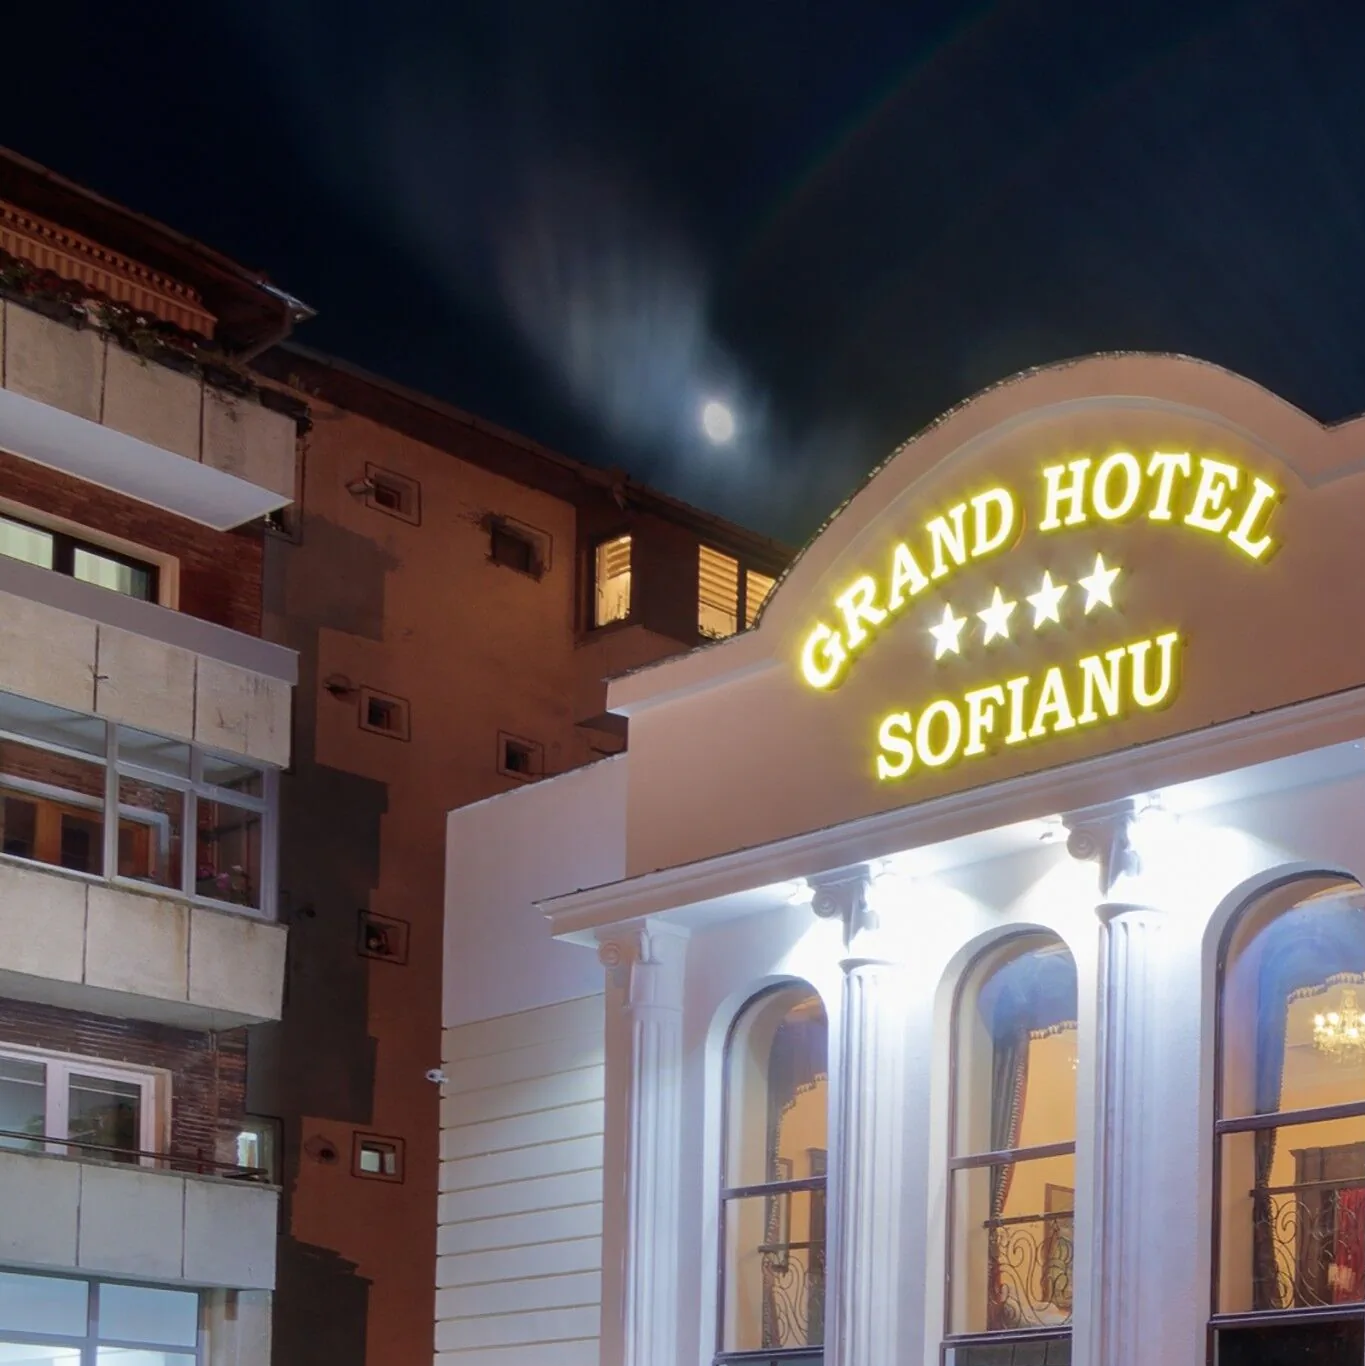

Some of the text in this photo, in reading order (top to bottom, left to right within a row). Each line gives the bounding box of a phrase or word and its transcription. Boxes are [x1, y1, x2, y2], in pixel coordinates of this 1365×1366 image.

[800, 451, 1278, 690] GRAND HOTEL
[877, 631, 1179, 781] SOFIANU
